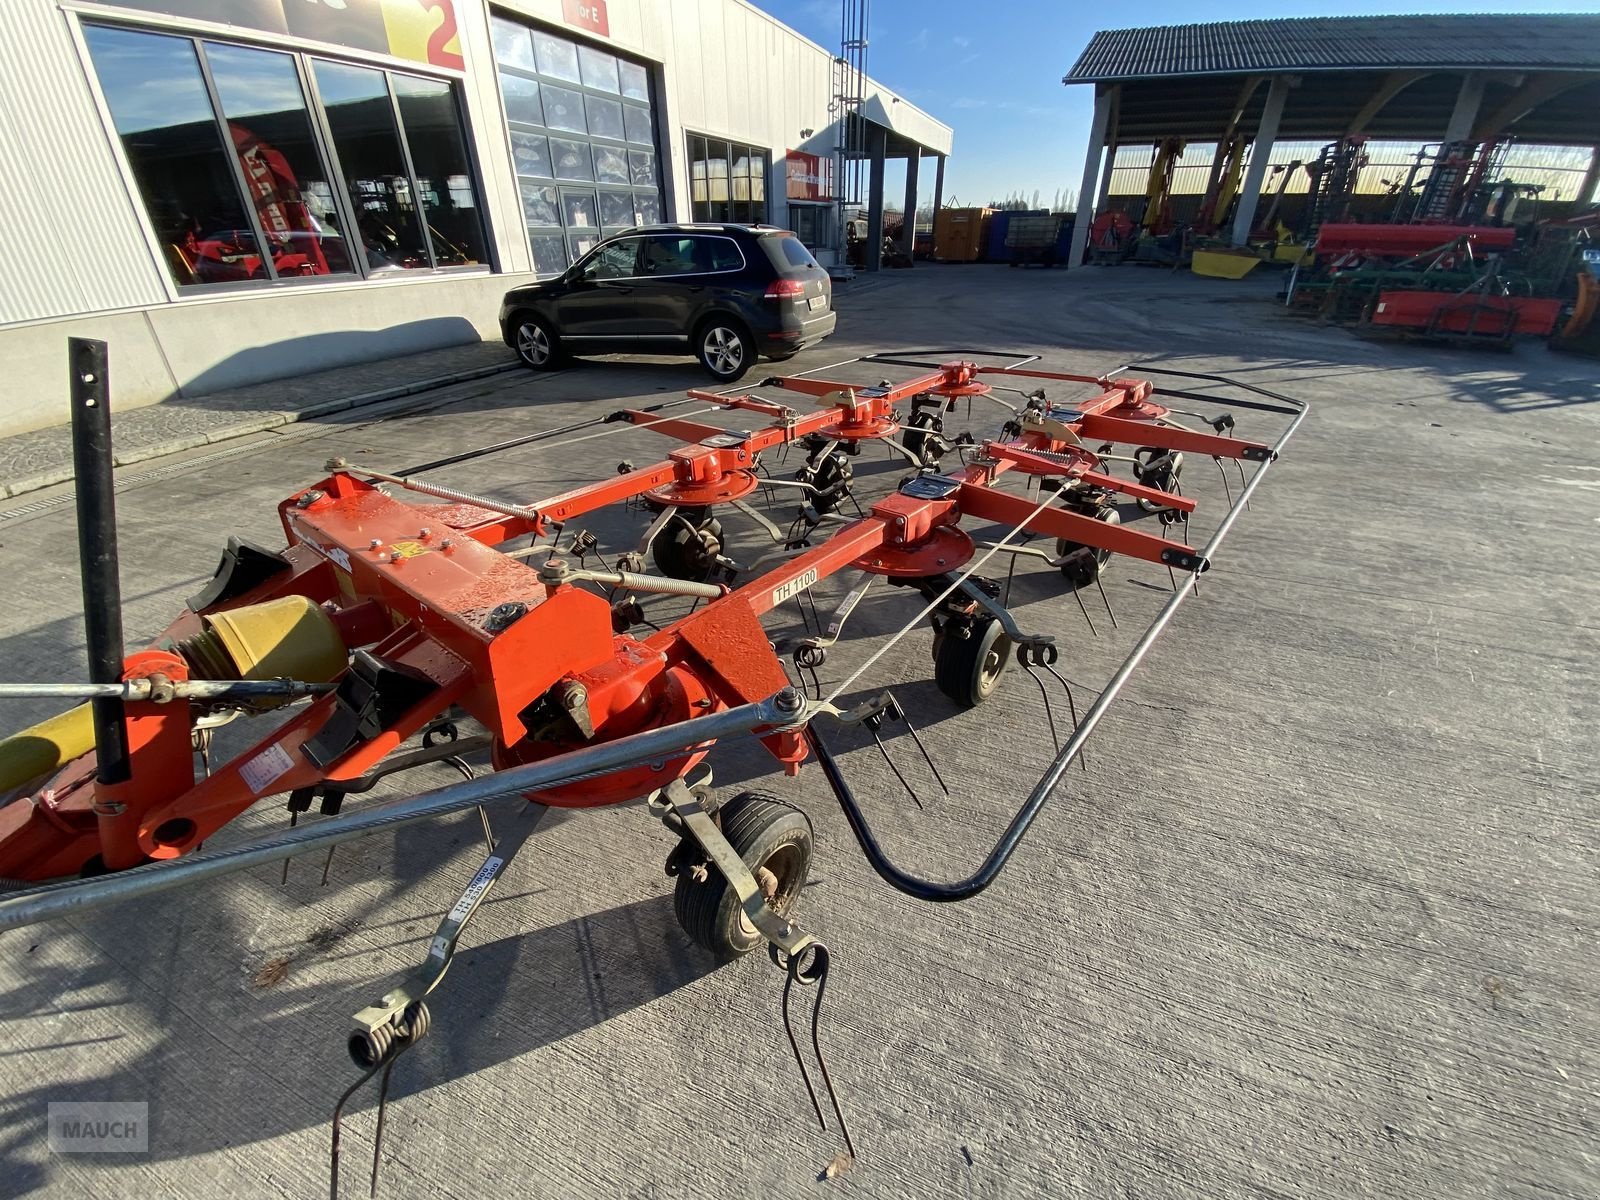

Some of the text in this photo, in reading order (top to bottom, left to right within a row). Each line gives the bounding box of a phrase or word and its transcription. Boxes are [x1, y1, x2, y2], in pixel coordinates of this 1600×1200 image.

[592, 6, 599, 23] E
[421, 0, 466, 71] 2
[776, 569, 816, 601] TH 1100
[460, 902, 471, 914] TH
[471, 885, 483, 900] 530
[485, 863, 499, 880] 1300
[454, 901, 465, 912] TH
